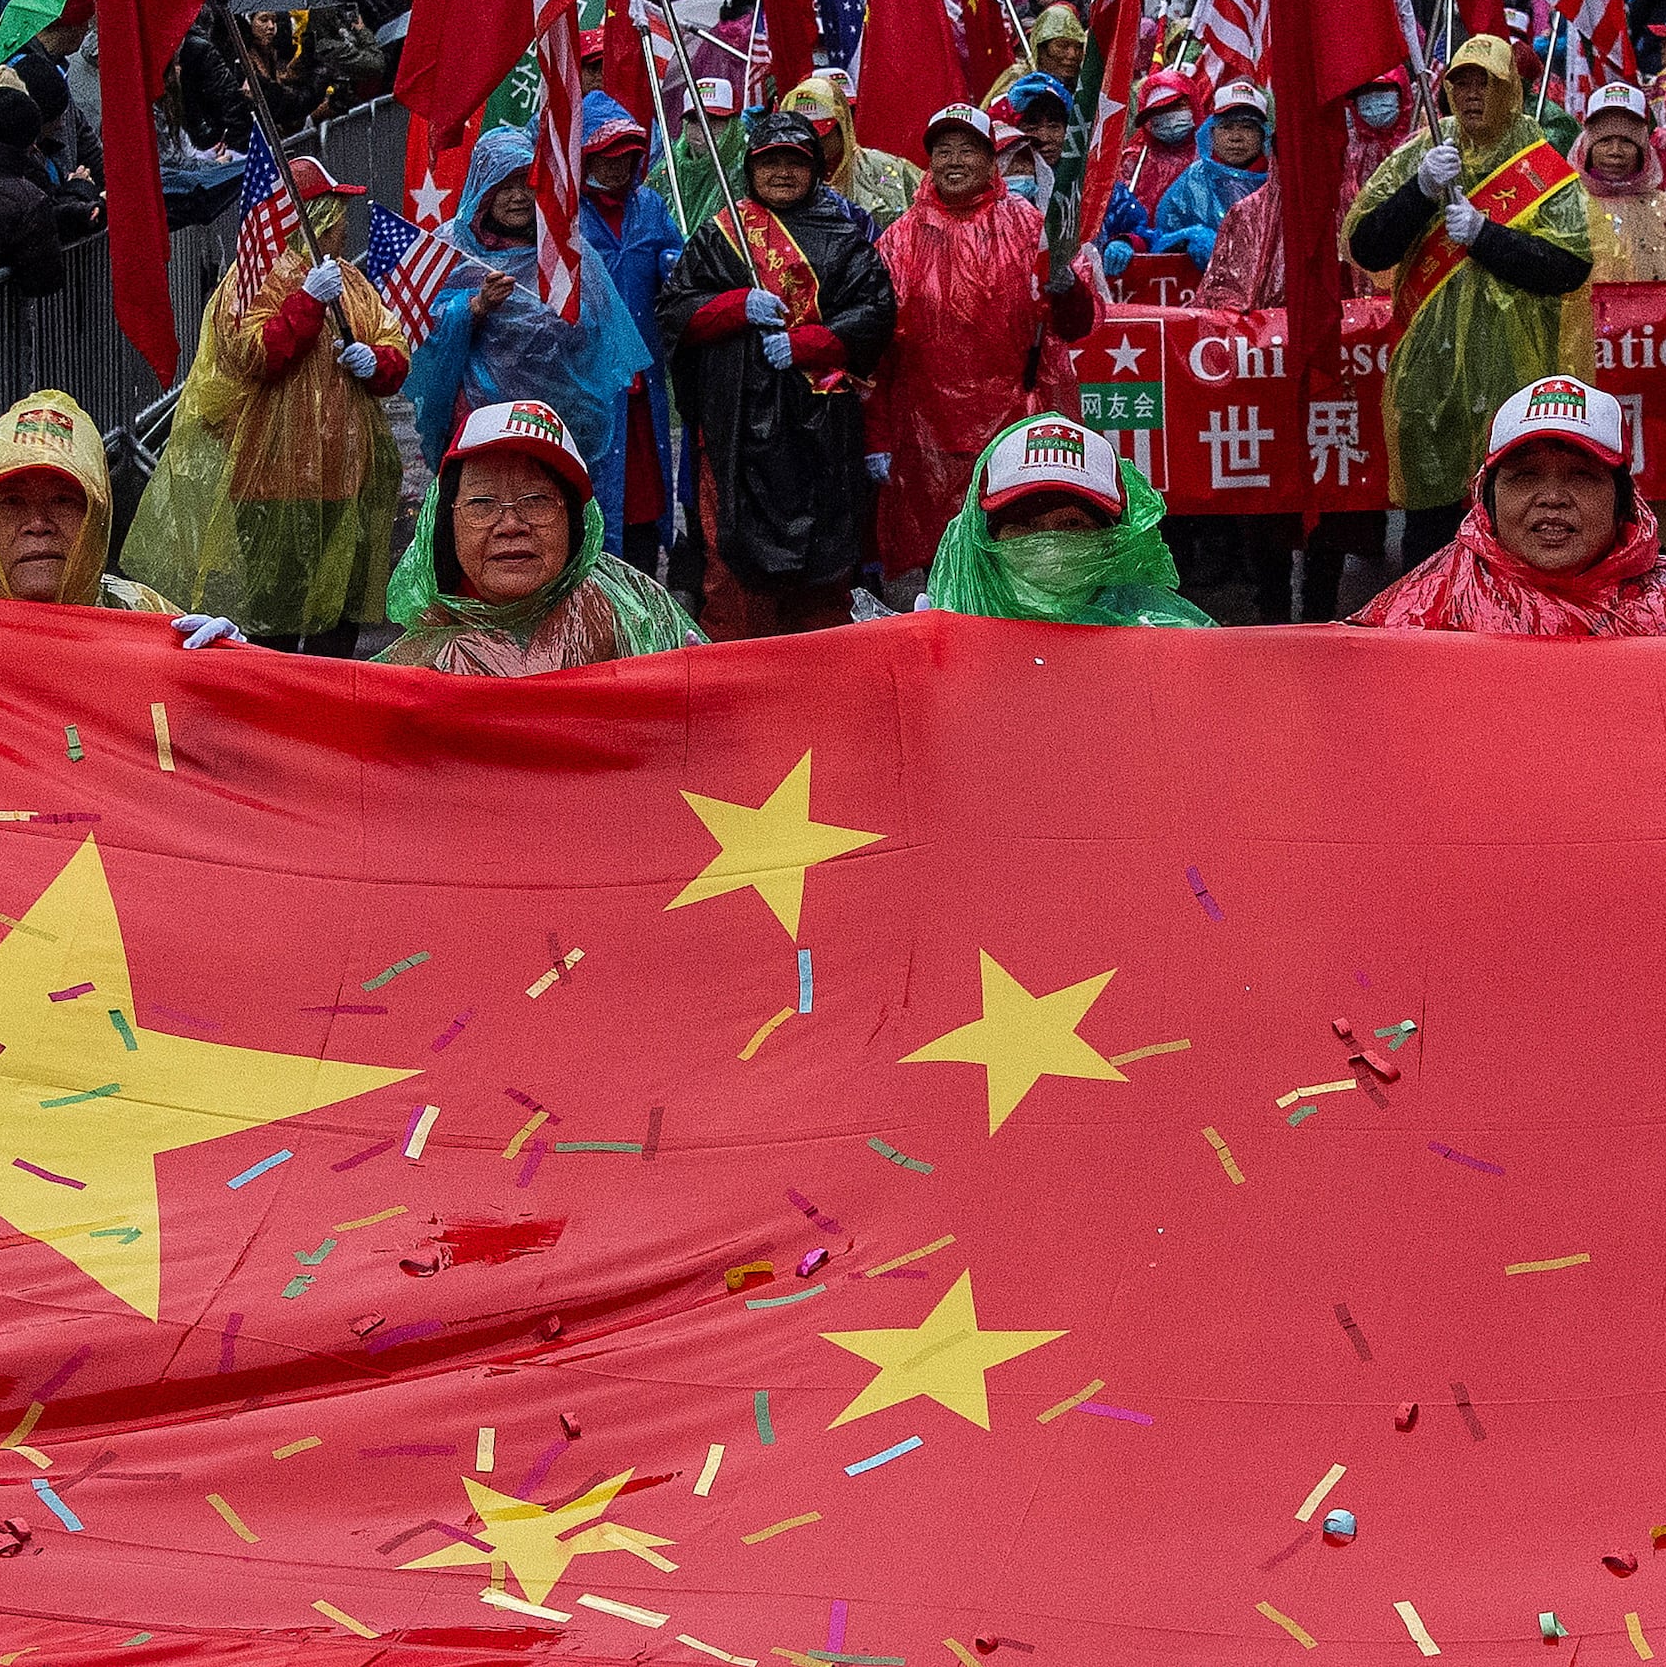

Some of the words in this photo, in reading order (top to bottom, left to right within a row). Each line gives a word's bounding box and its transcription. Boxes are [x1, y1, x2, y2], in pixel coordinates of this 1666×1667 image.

[1189, 335, 1391, 383] Chiese
[1081, 392, 1156, 420] 网友会
